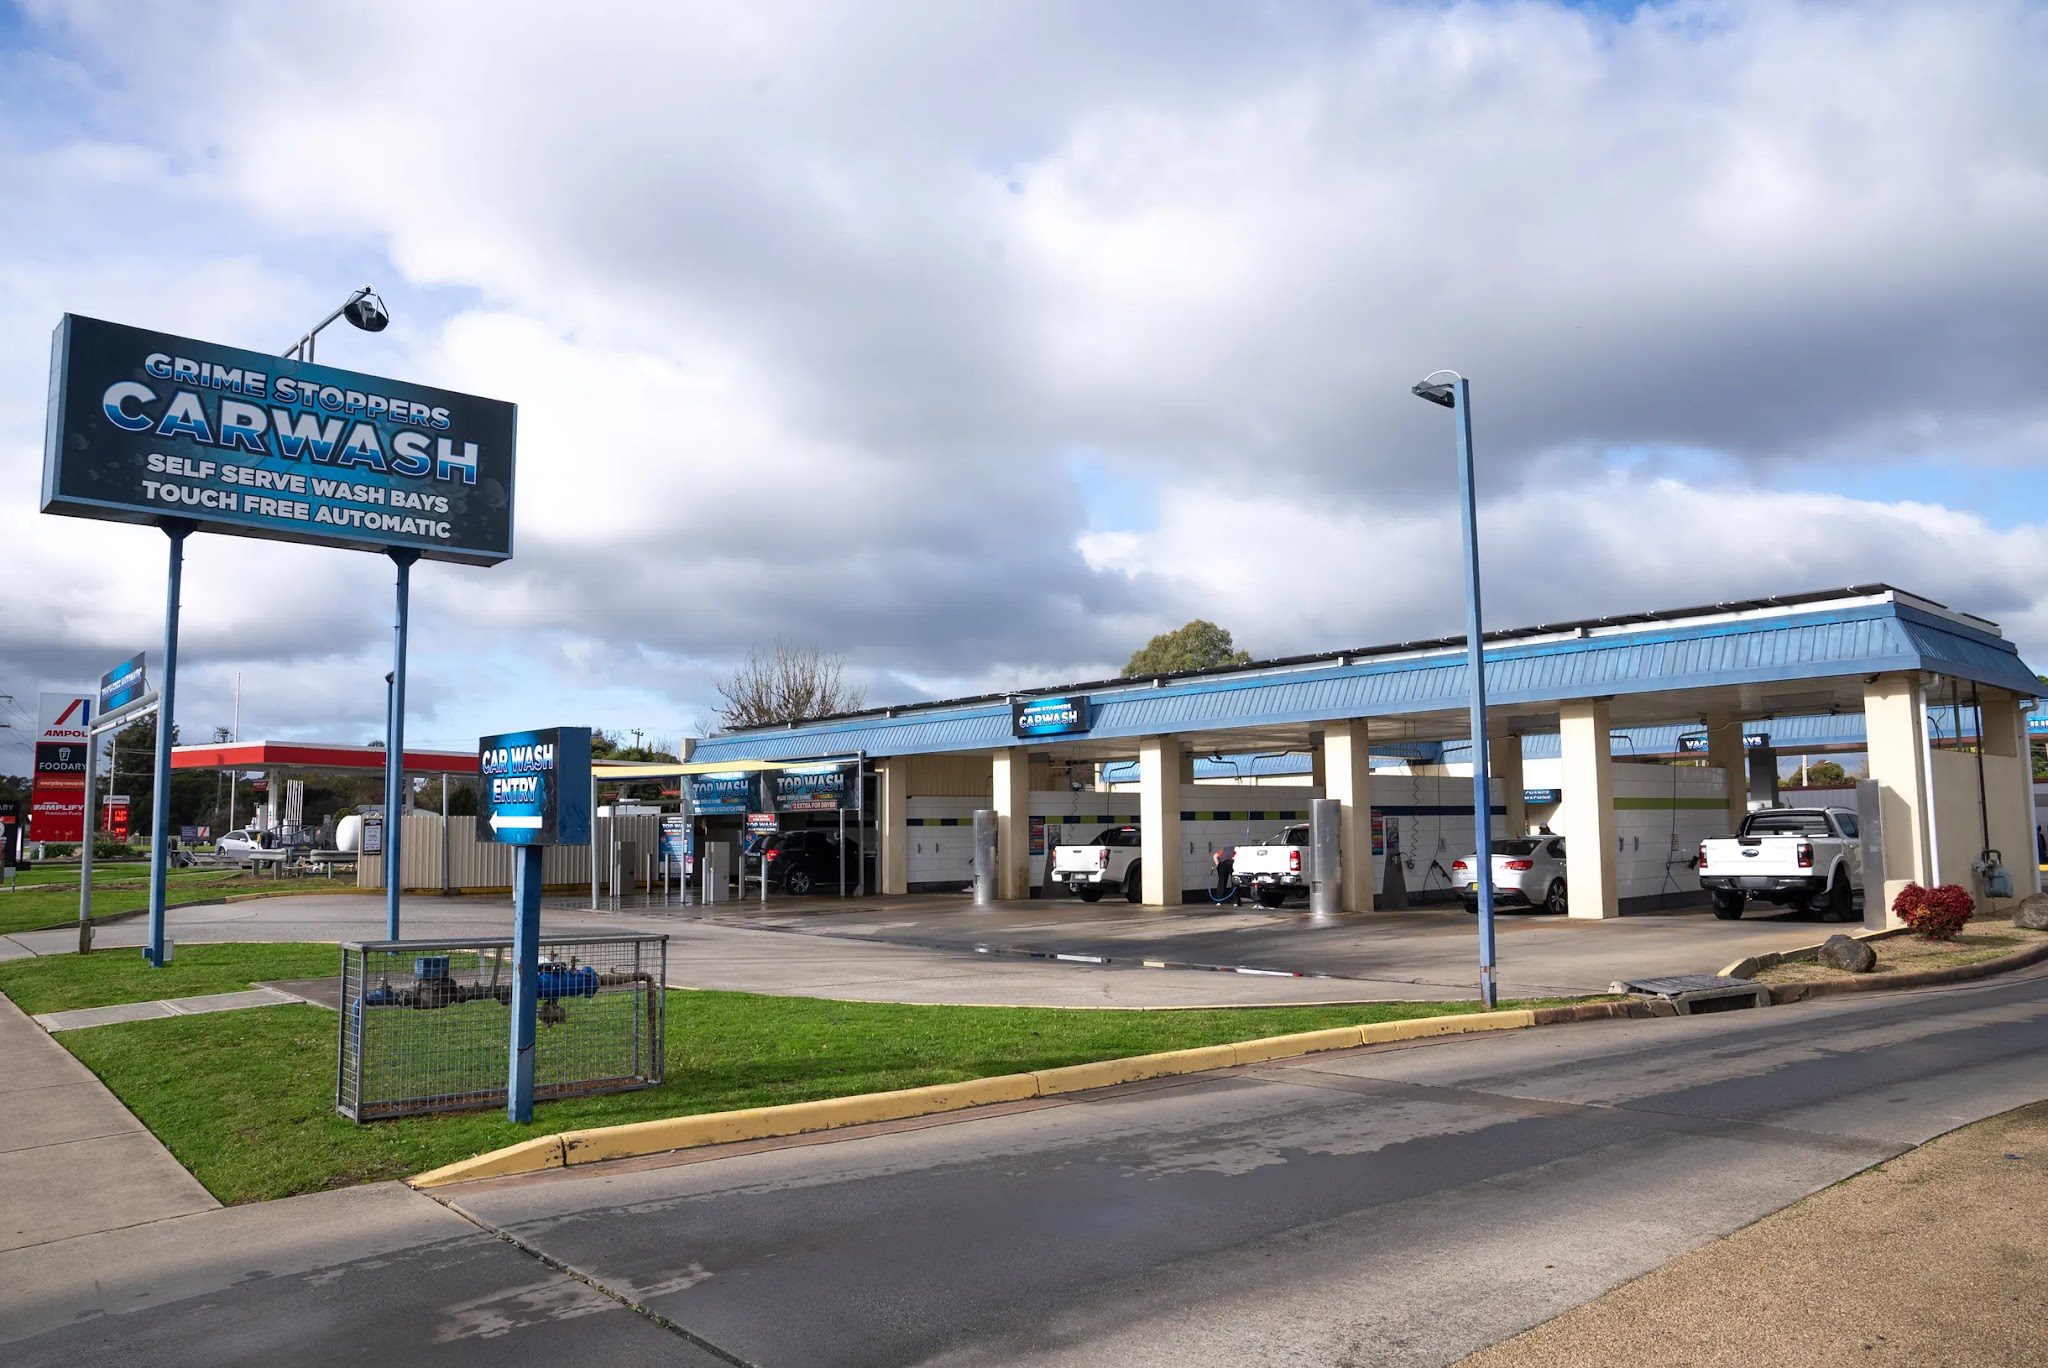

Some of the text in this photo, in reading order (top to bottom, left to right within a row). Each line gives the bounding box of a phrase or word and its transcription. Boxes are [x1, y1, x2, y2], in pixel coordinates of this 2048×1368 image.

[144, 353, 450, 430] GRIME STOPPERS
[103, 380, 479, 485] CARWASH
[147, 453, 449, 513] SELF SERVE WASH BAYS
[142, 480, 451, 539] TOUCH FREE AUTOMATIC
[1019, 710, 1077, 728] CARWASH
[39, 762, 87, 770] FOODARY
[482, 744, 554, 775] CAR WASH
[493, 777, 538, 803] ENTRY
[693, 780, 749, 798] TOP WASH
[777, 773, 844, 793] TOP WASH
